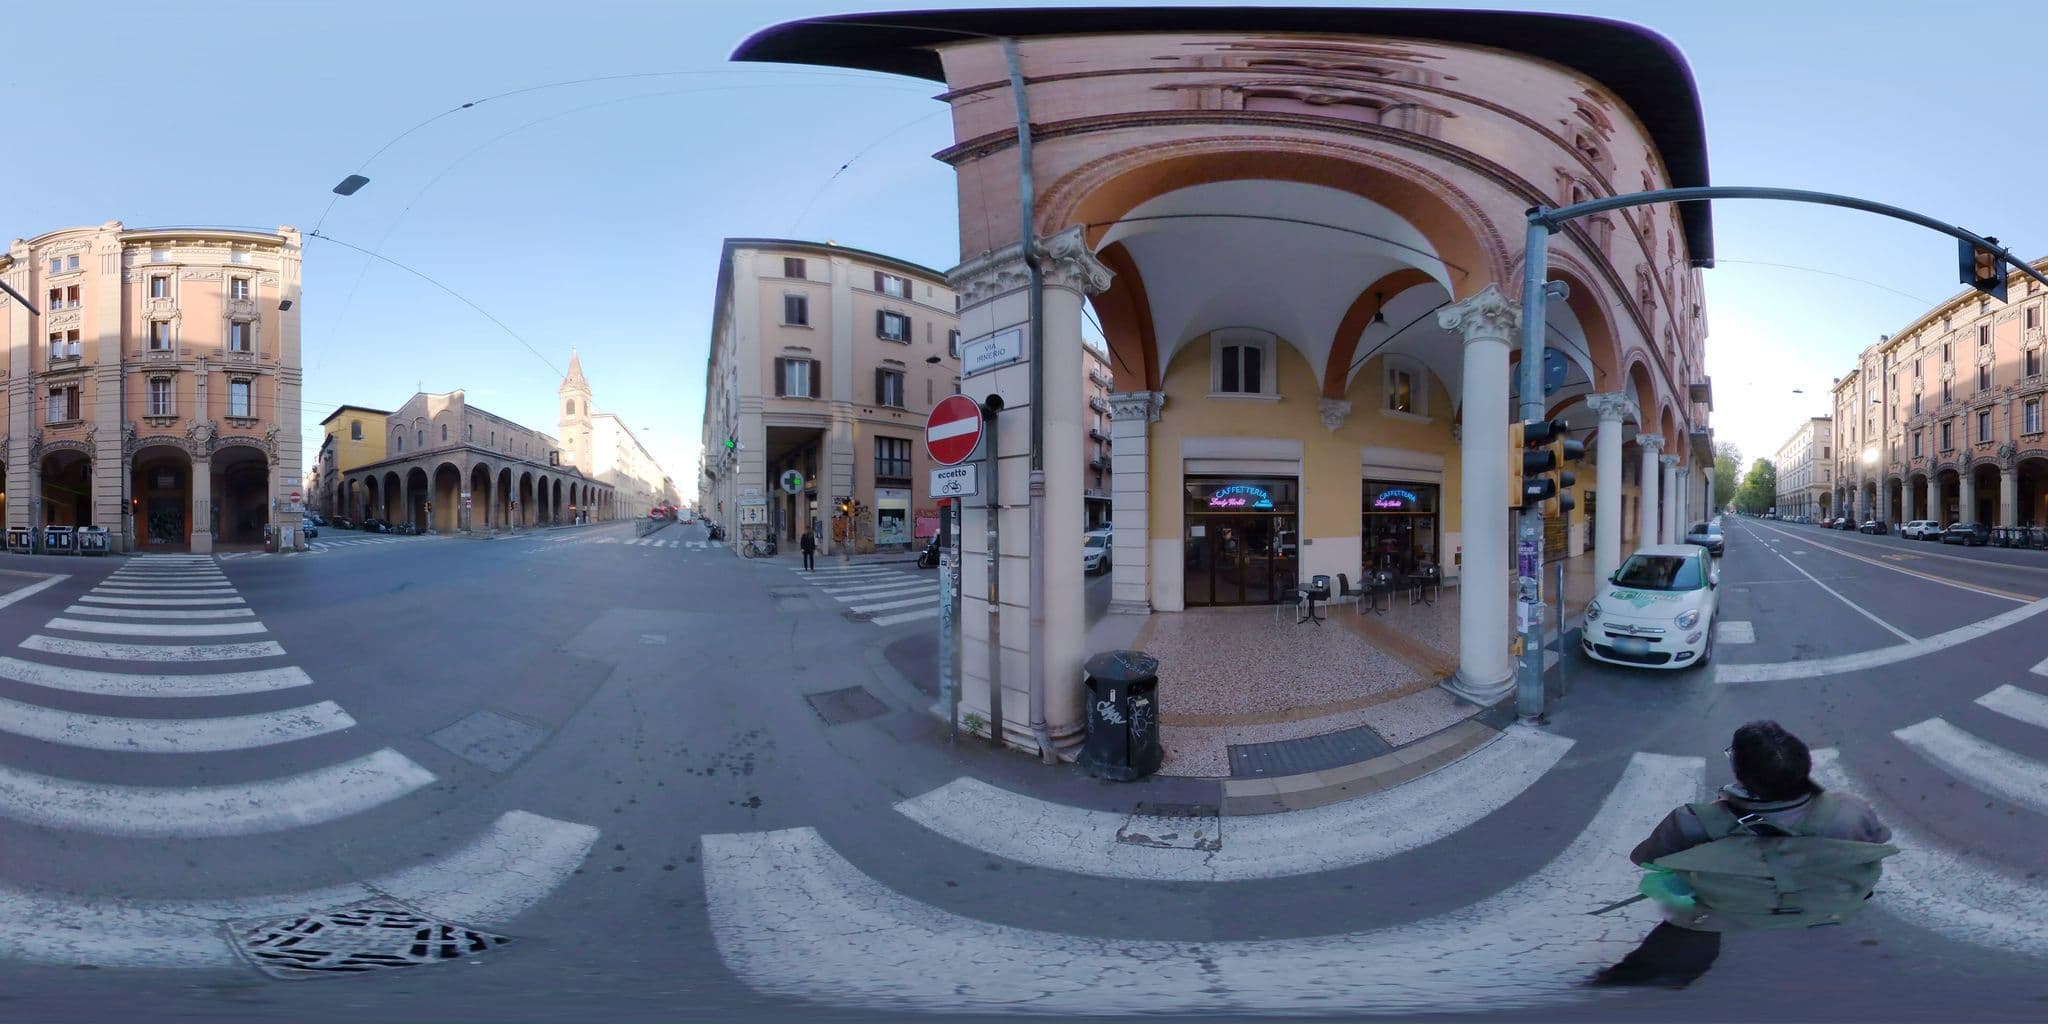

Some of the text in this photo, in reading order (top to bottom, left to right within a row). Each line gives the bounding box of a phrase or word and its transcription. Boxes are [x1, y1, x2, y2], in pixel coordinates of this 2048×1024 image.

[984, 343, 996, 352] VIA
[976, 348, 1006, 364] IRNERIO
[938, 468, 967, 479] eccetto
[1216, 485, 1267, 499] CAFFETTERIA
